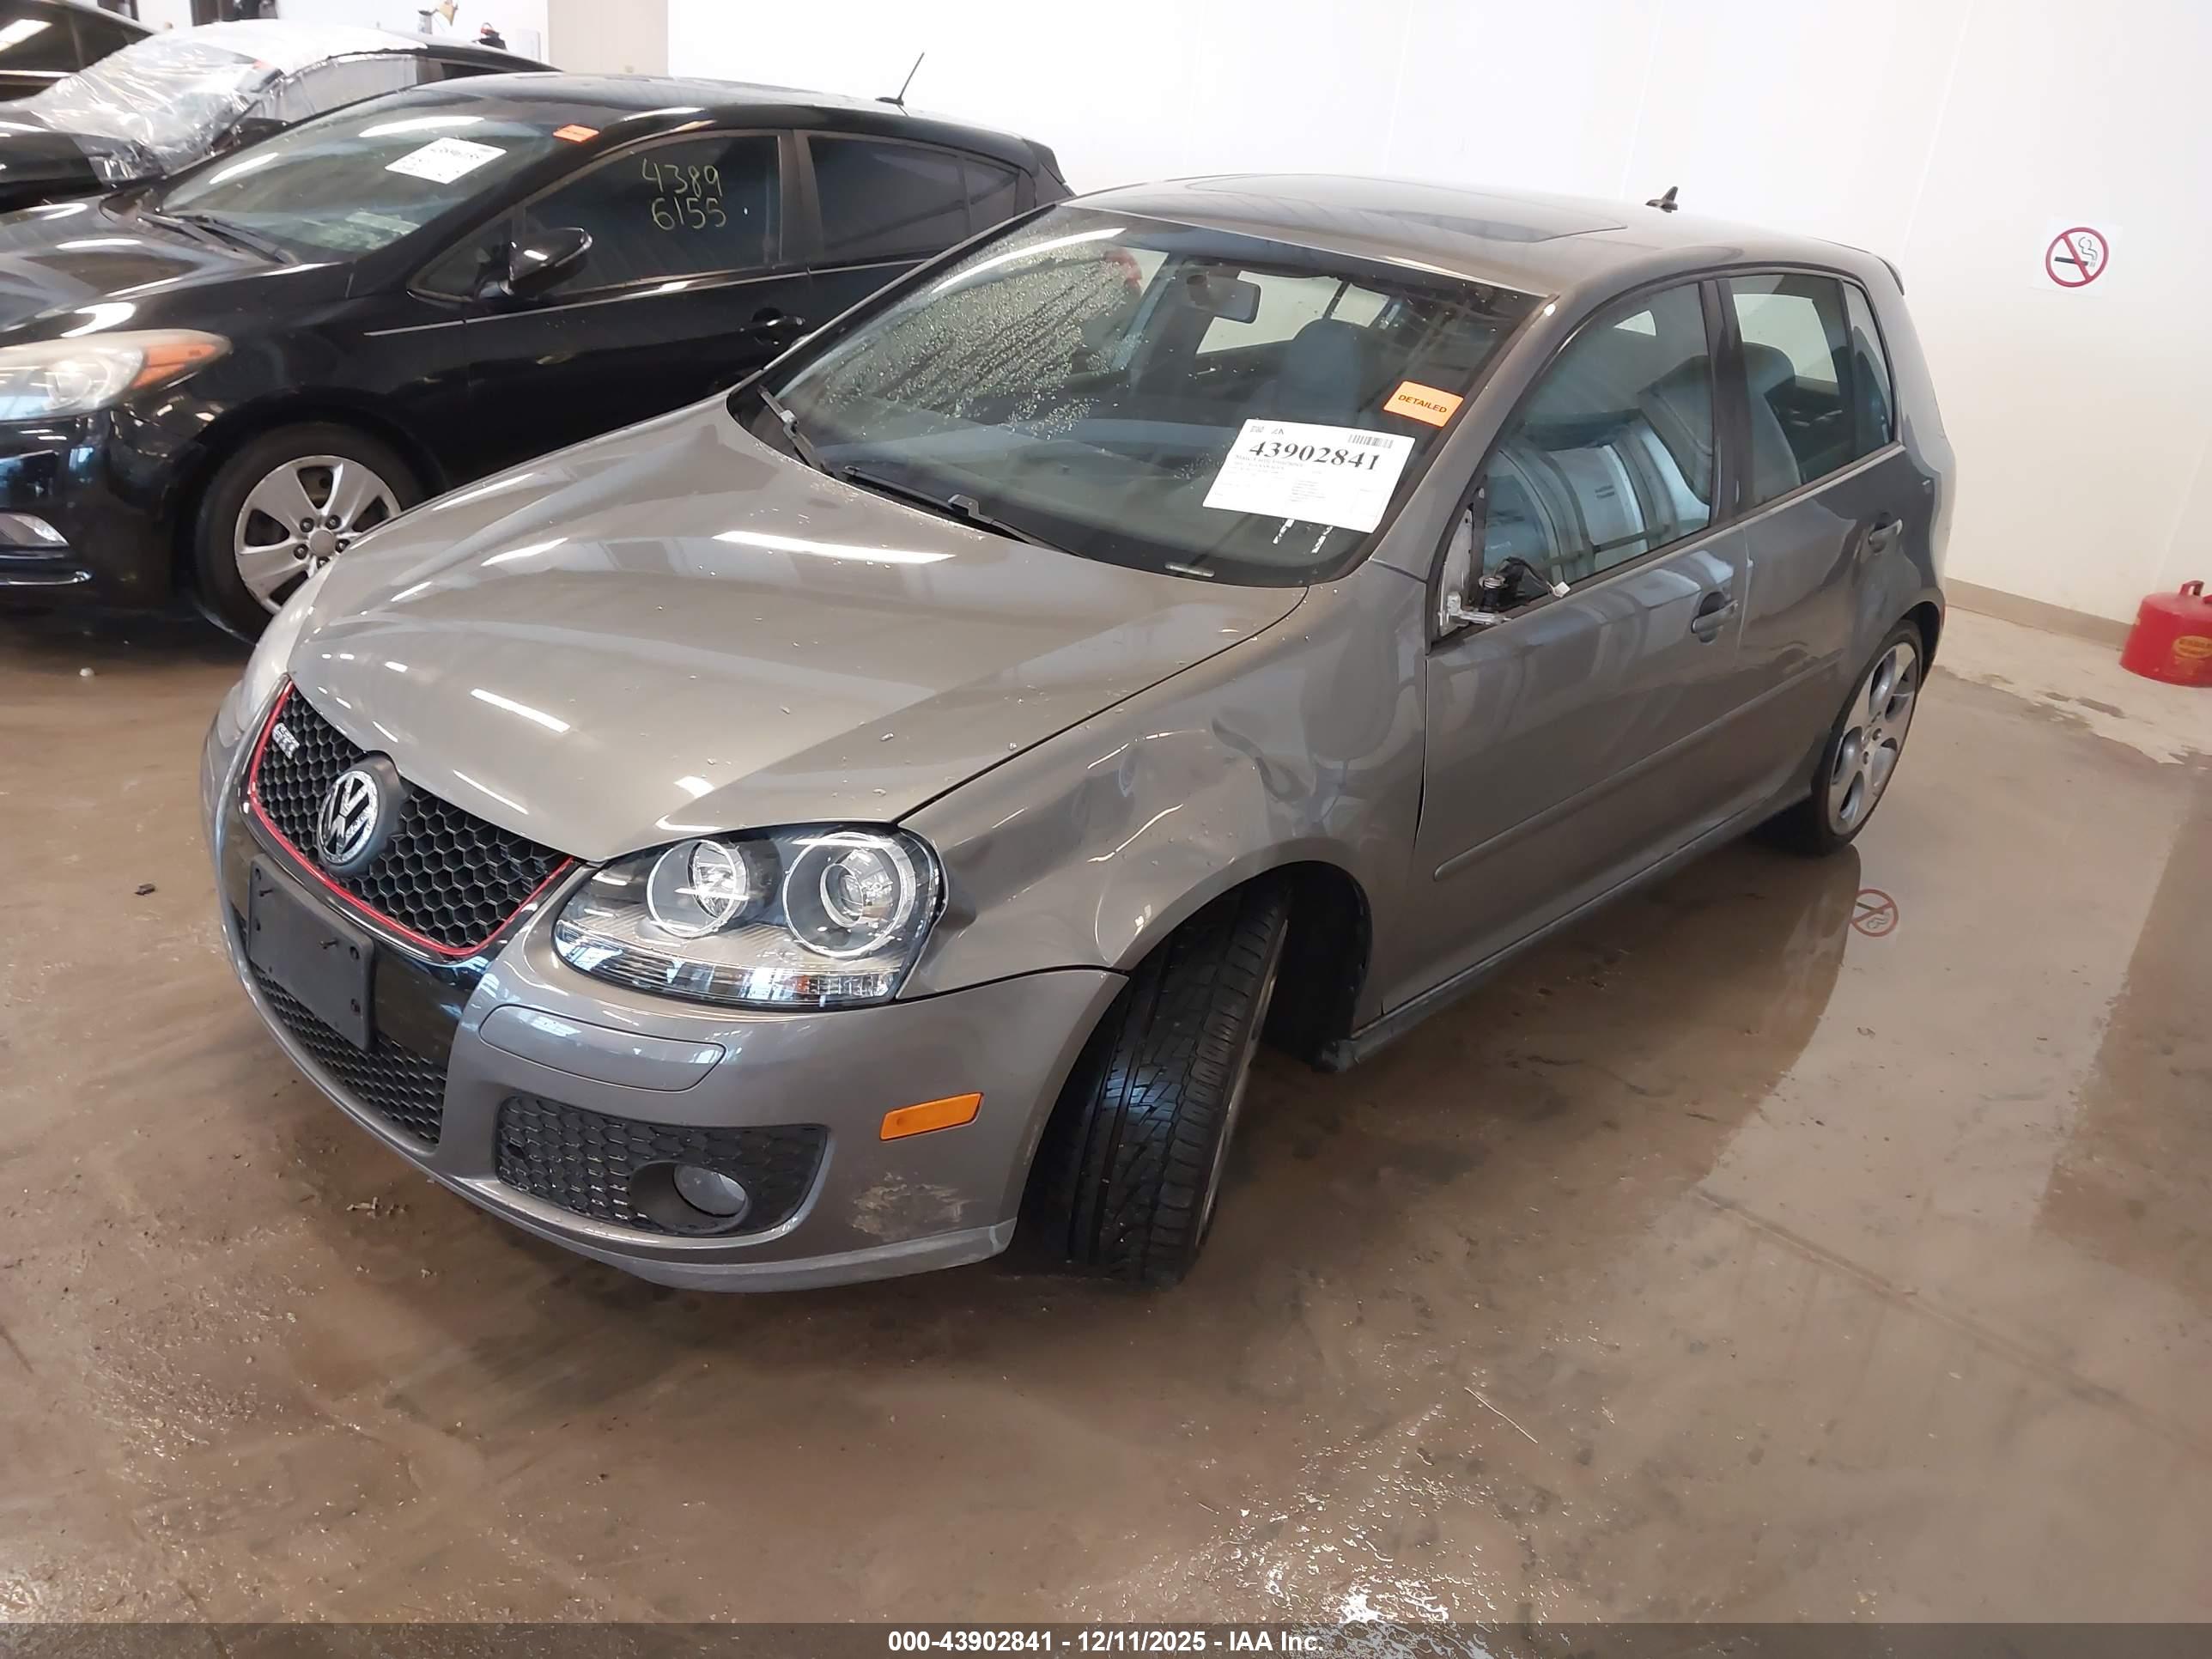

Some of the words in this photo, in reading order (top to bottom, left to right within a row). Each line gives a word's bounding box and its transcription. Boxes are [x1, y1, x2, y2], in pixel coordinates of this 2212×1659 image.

[642, 158, 723, 198] 4389
[652, 197, 726, 230] 6155
[1397, 393, 1448, 414] DETAILED
[1249, 441, 1380, 471] 43902841
